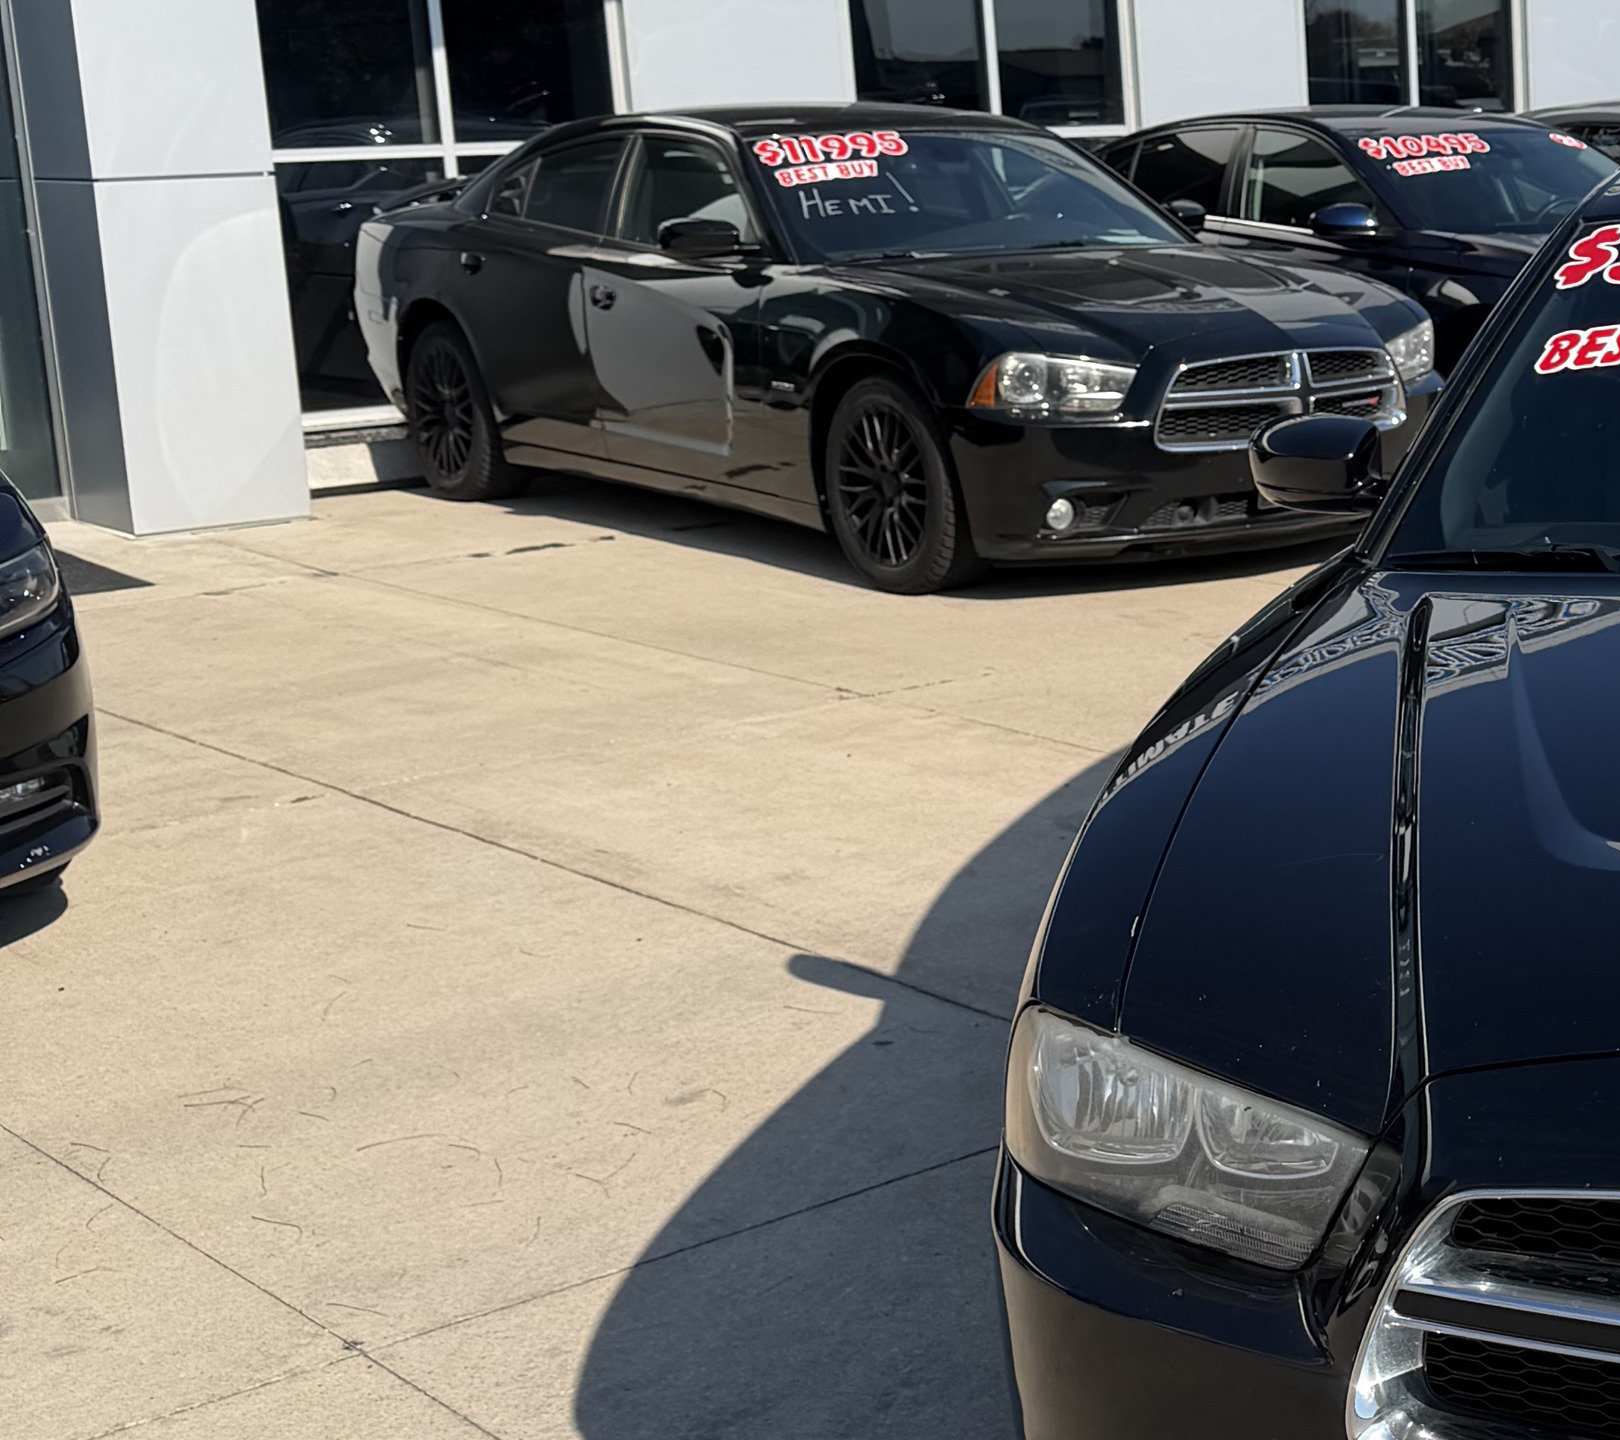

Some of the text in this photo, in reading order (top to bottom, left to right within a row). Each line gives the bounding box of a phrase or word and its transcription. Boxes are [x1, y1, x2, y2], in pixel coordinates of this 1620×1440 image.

[753, 131, 908, 166] $11995
[1358, 133, 1490, 159] $10495
[777, 160, 877, 186] BEST BUY
